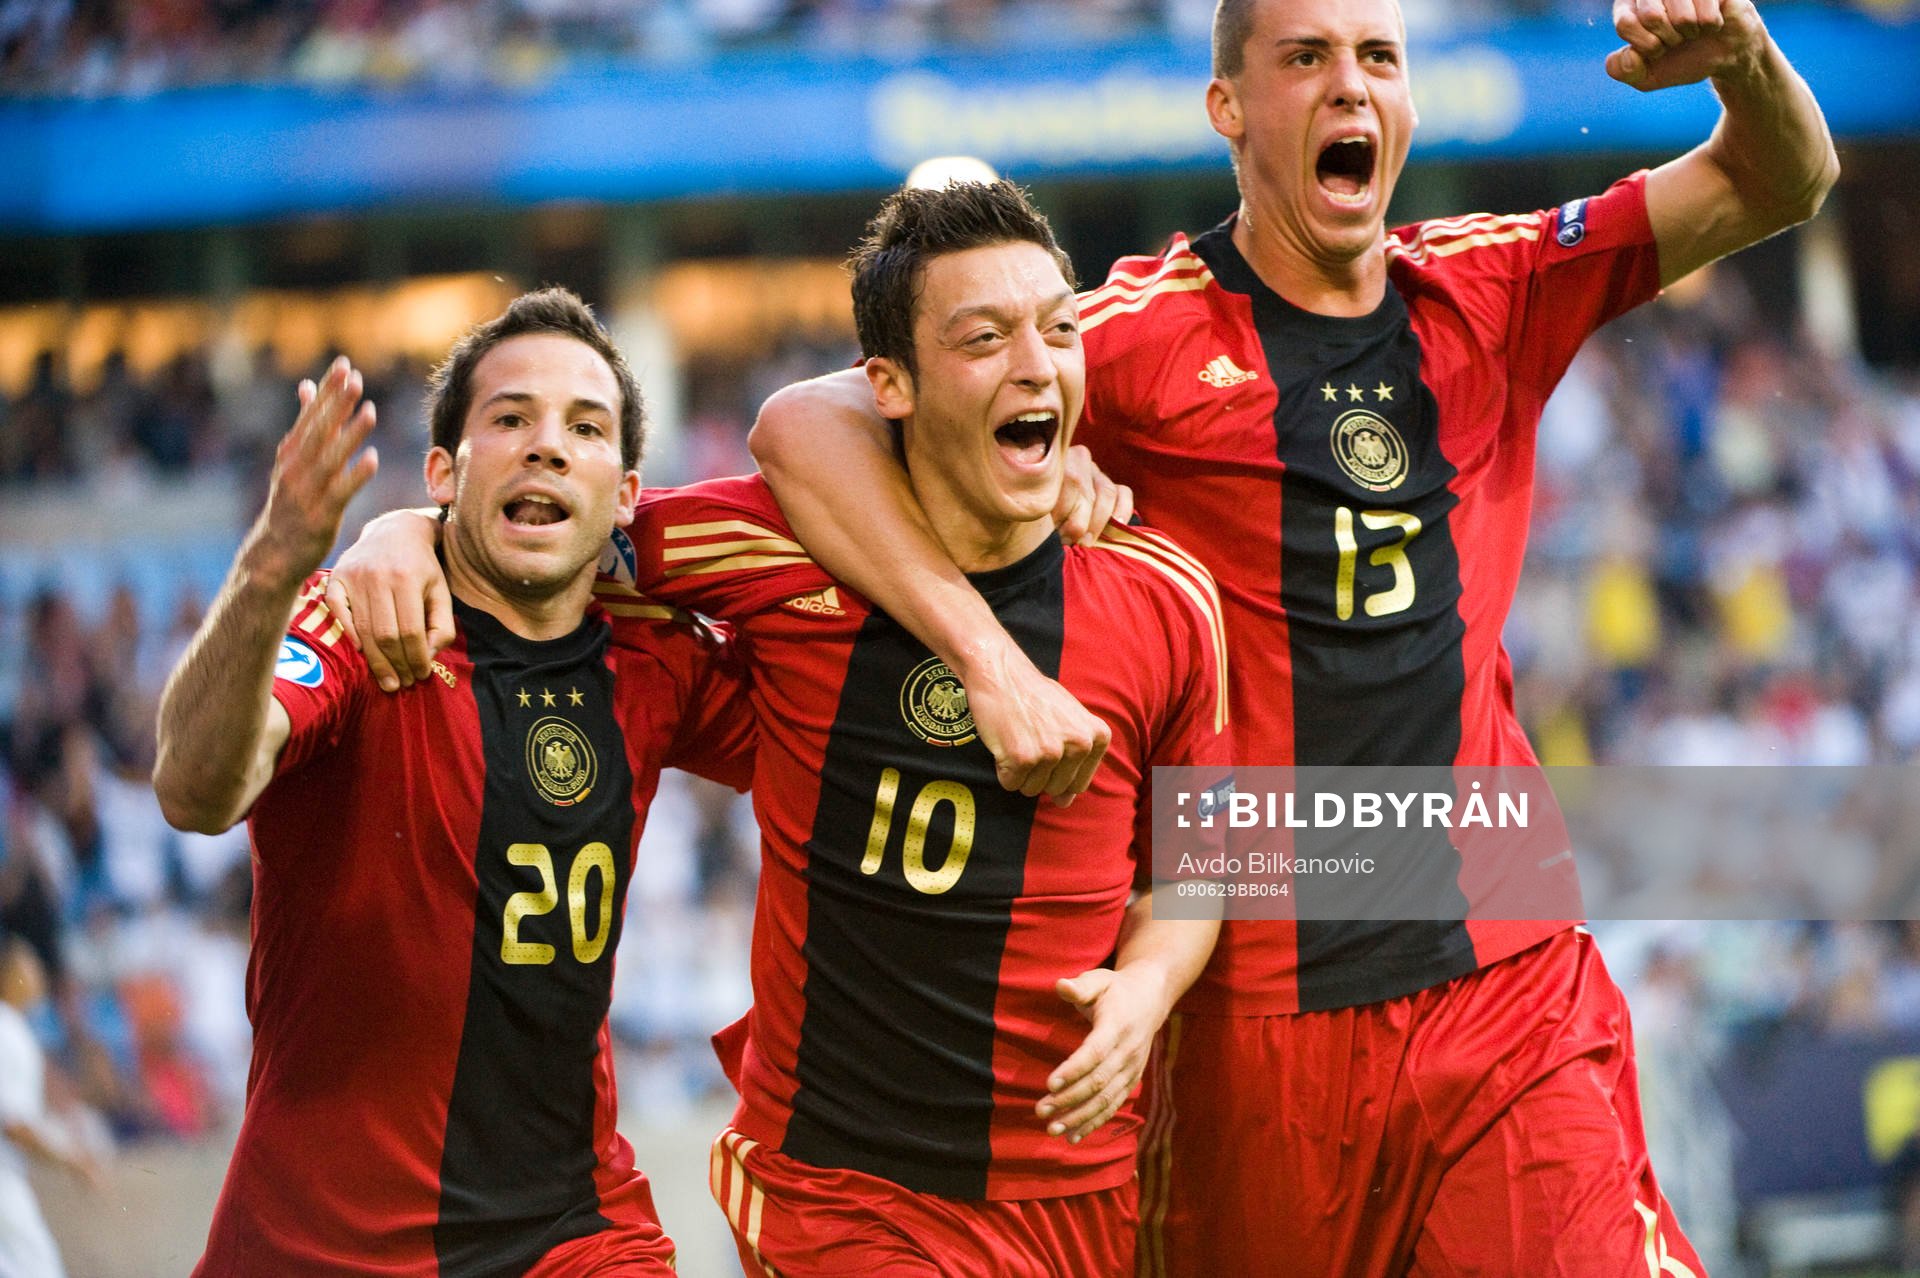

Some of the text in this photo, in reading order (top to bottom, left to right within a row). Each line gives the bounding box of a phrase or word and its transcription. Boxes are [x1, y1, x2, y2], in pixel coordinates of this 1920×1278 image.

[1198, 369, 1258, 388] adidas
[1335, 506, 1422, 620] 13
[860, 767, 976, 895] 10
[501, 842, 616, 965] 20
